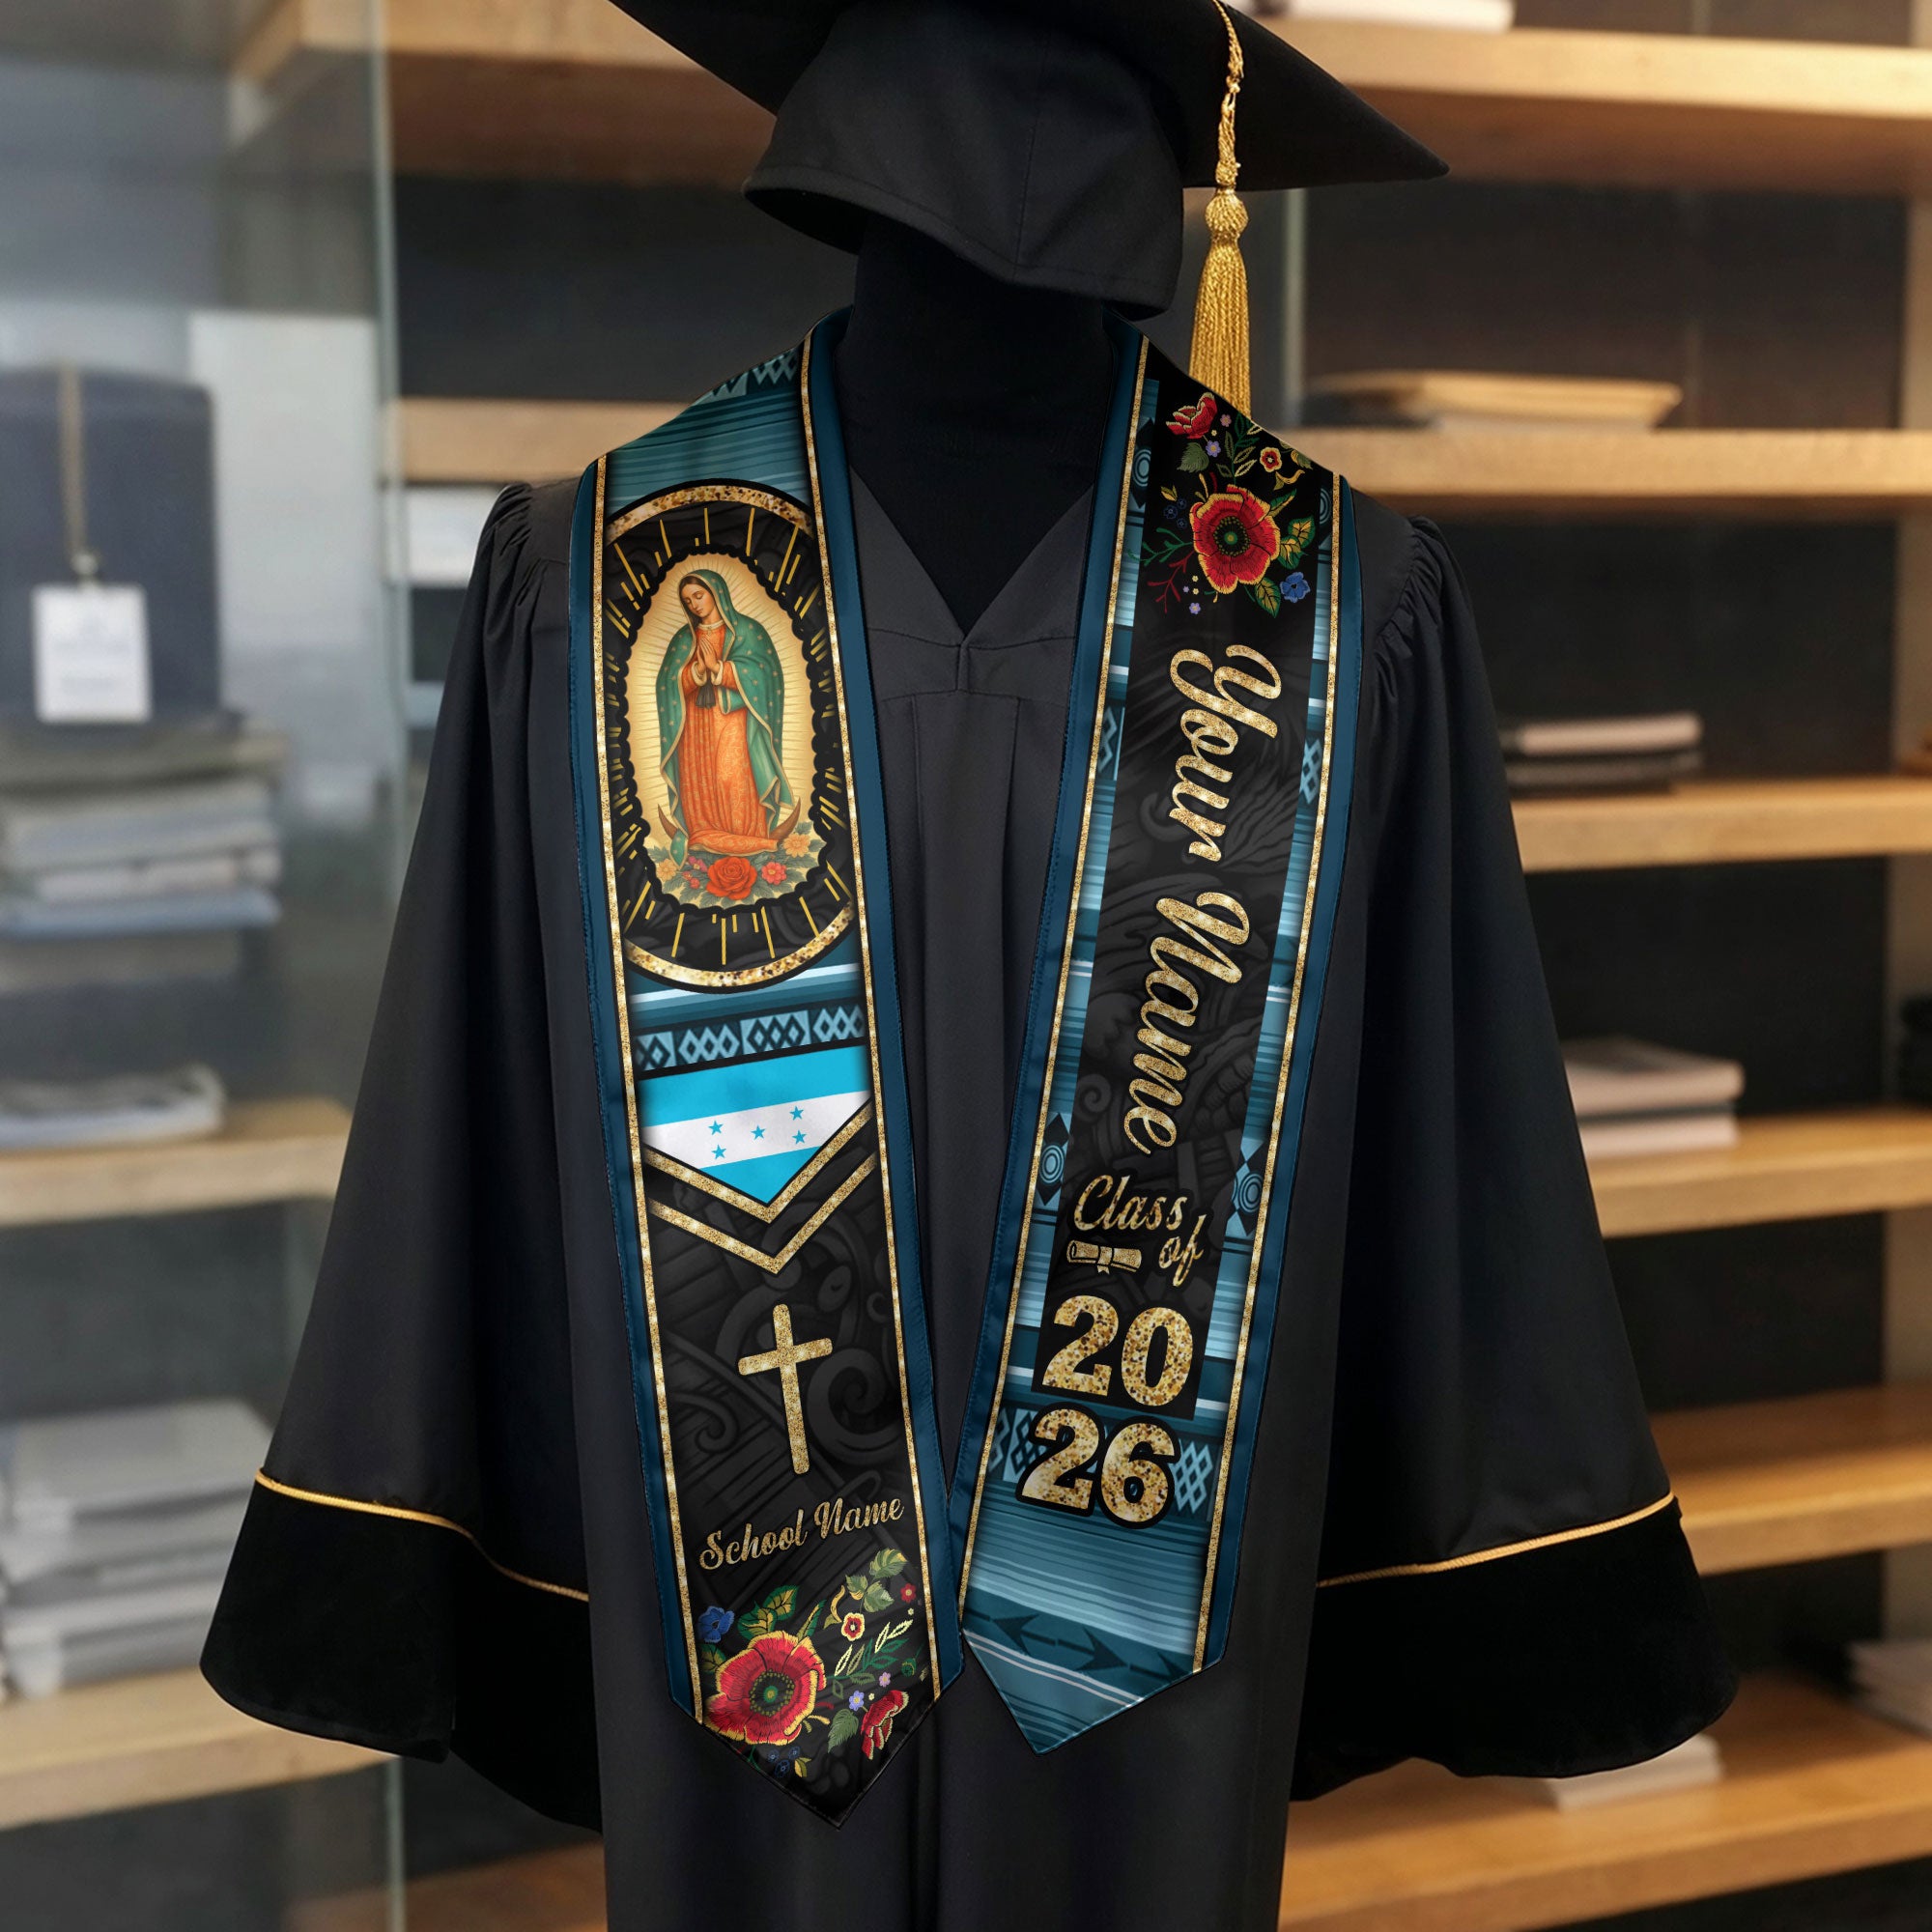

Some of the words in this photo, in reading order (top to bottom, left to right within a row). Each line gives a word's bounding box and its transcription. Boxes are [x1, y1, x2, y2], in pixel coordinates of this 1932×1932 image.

[1170, 644, 1282, 863] Your
[1123, 892, 1250, 1155] Name
[1073, 1175, 1188, 1232] Class
[1159, 1214, 1207, 1287] of
[1041, 1294, 1193, 1406] 20
[1021, 1408, 1176, 1522] 26
[698, 1509, 808, 1571] School
[813, 1497, 905, 1540] Name
